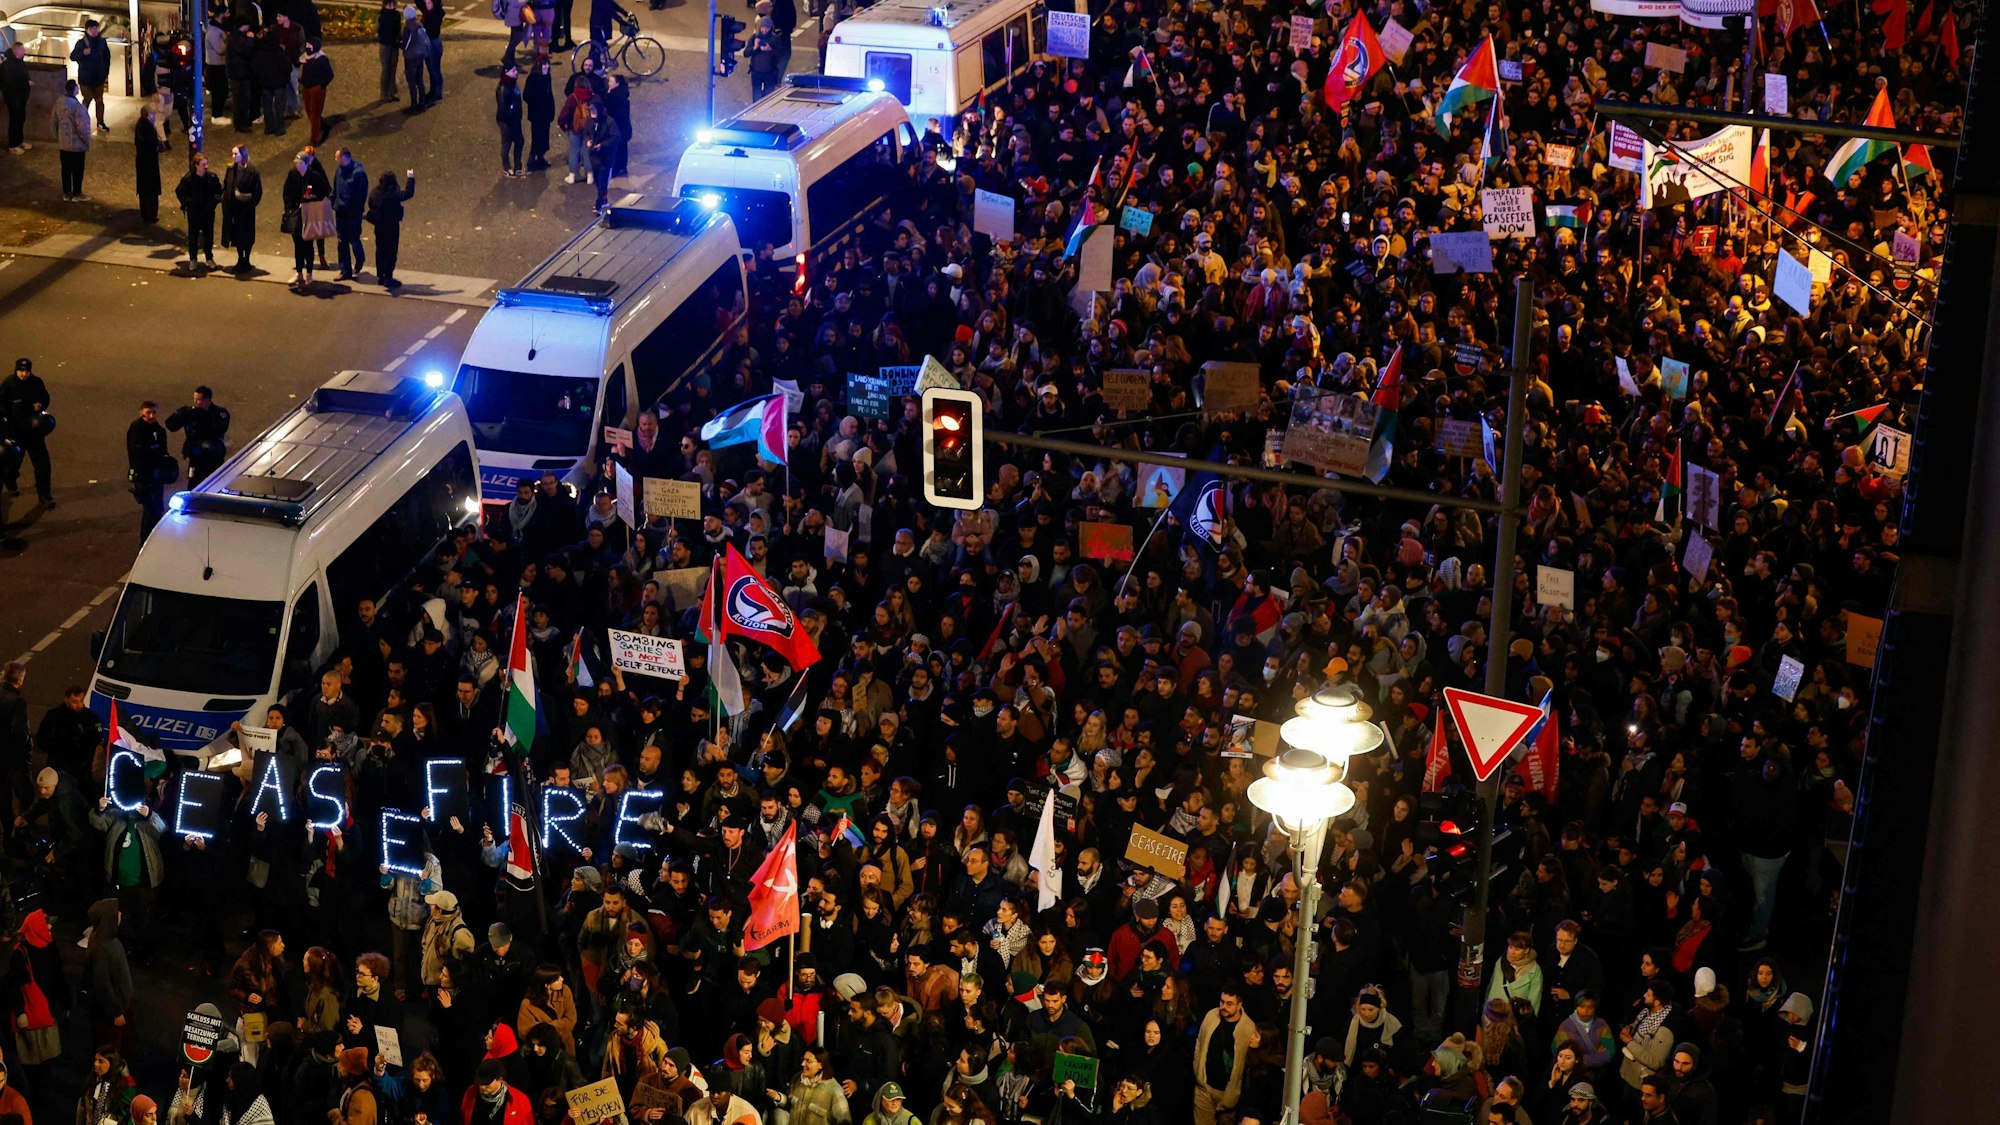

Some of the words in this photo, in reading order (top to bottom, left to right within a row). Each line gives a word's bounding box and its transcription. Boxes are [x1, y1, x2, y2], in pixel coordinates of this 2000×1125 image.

[1051, 12, 1087, 23] DEUTSCHE
[1614, 141, 1627, 149] UND
[1486, 189, 1526, 197] HUNDREDS
[1493, 205, 1521, 213] RUBBLE
[1496, 199, 1520, 207] UNDER
[1483, 211, 1533, 224] CEASEFIRE
[1498, 223, 1525, 233] NOW
[481, 472, 521, 488] LIZE
[645, 504, 696, 519] JERUSALEM
[732, 613, 769, 630] ACTION
[612, 631, 676, 650] BOMBING
[619, 641, 663, 657] BABIES
[623, 650, 634, 659] IS
[638, 653, 661, 664] NOT
[615, 657, 642, 671] SELF
[644, 662, 685, 677] DEFENCE
[130, 713, 195, 736] OLIZEI
[196, 726, 217, 740] 15
[1130, 832, 1186, 866] CEASEFIRE
[187, 1012, 211, 1024] SCHLUSS
[210, 1018, 222, 1027] MIT
[184, 1025, 219, 1040] BESATZUNGS
[187, 1033, 214, 1046] TERRORS!
[1064, 1070, 1090, 1085] NOW
[570, 1092, 592, 1106] FÜR
[593, 1085, 610, 1097] DIE
[580, 1098, 622, 1123] MENSCHEN
